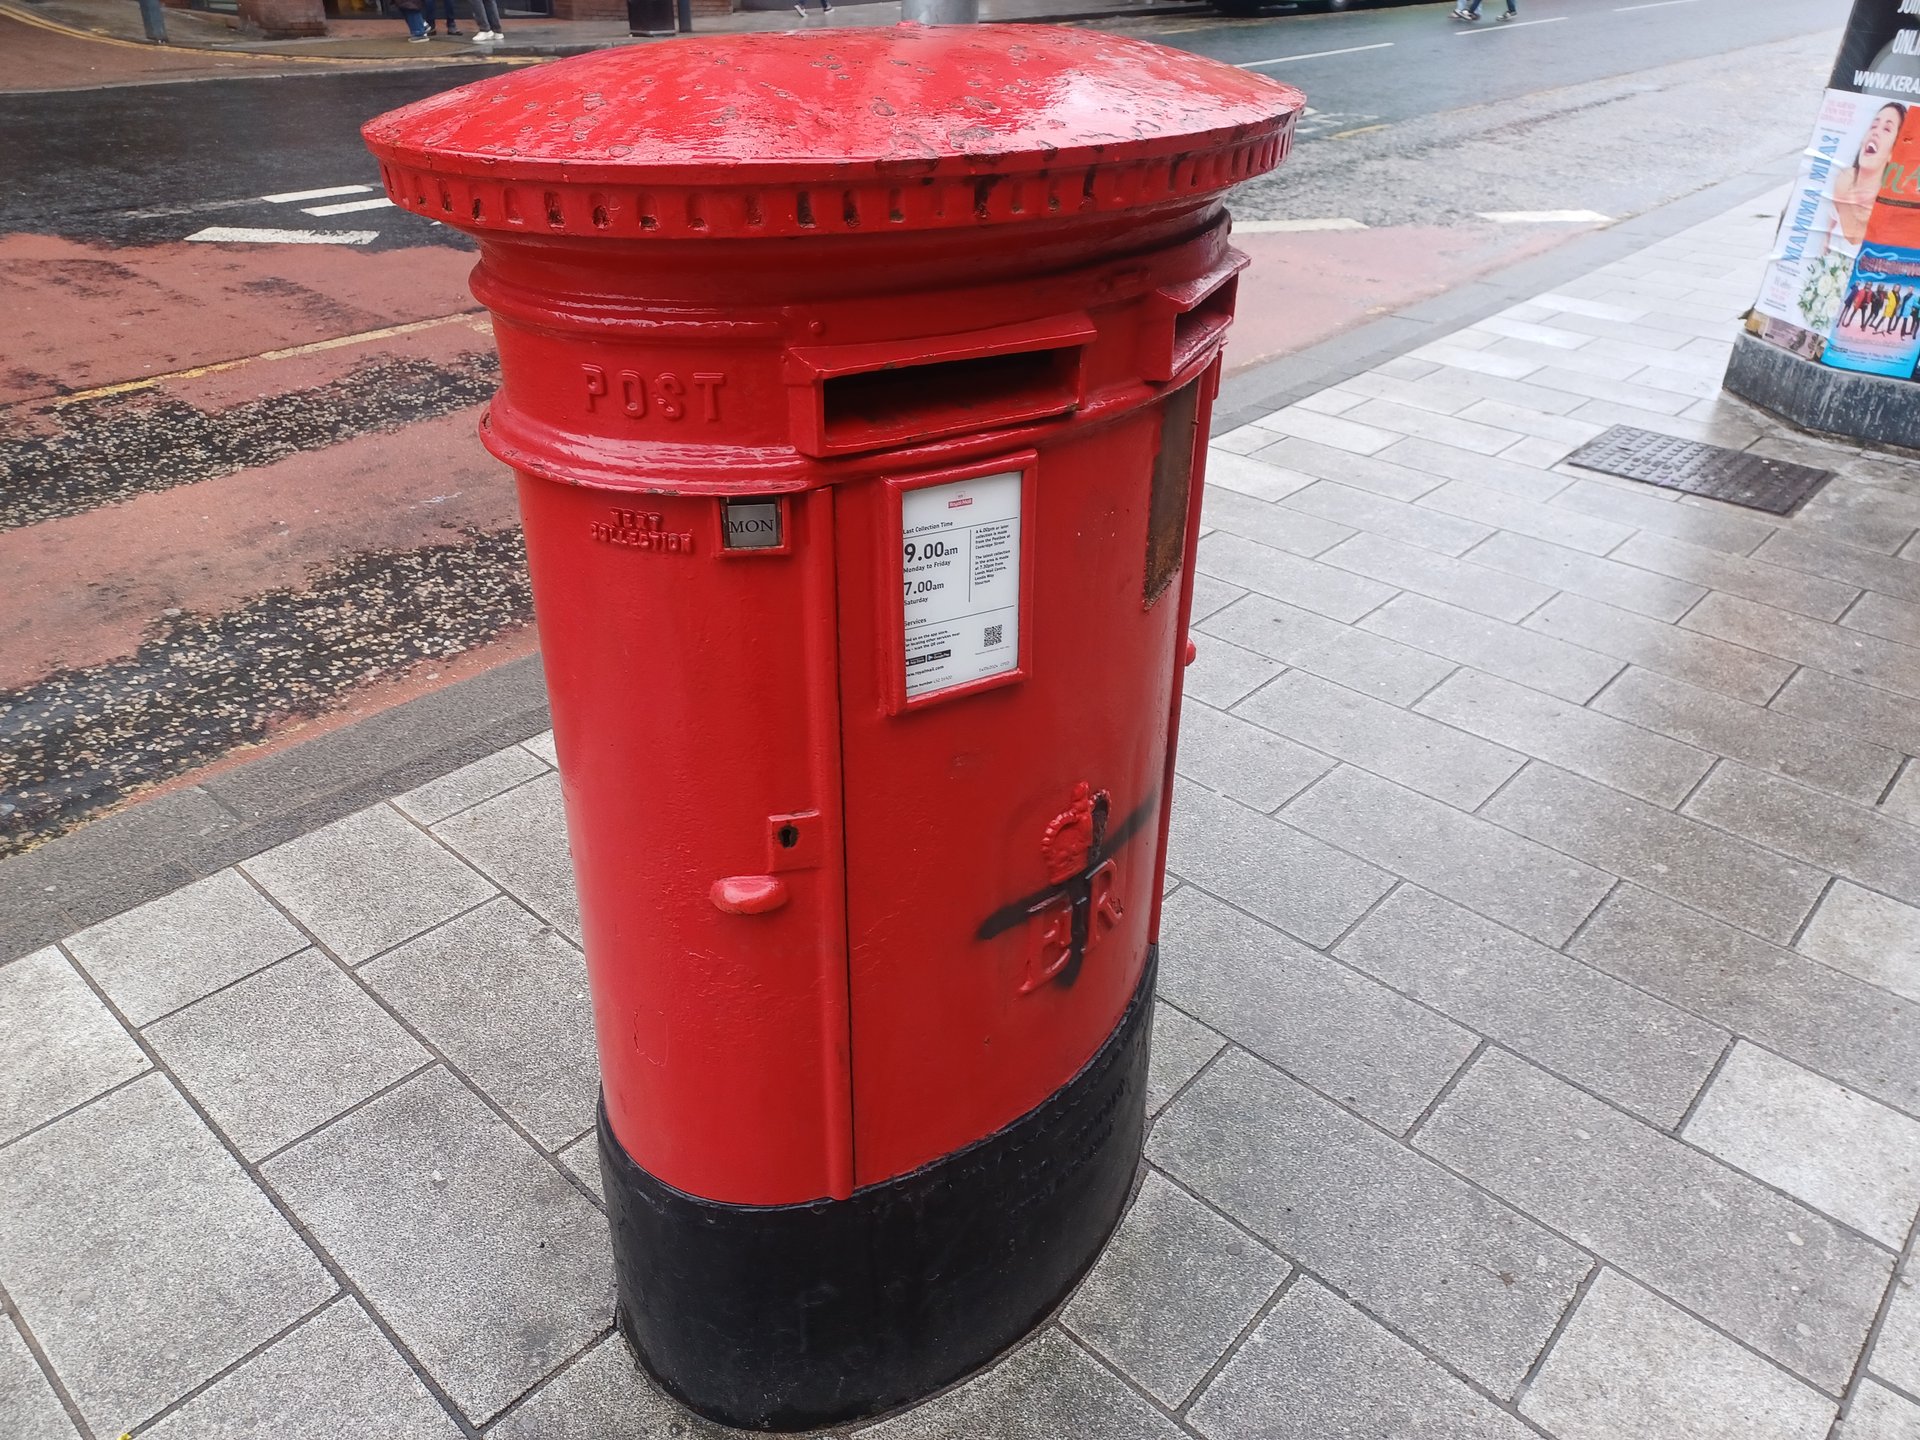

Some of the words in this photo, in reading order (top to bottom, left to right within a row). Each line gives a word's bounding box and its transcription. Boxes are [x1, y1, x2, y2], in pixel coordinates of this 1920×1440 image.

[1783, 188, 1822, 264] MAMMA
[581, 363, 726, 422] POST
[728, 518, 776, 535] MON
[916, 524, 940, 532] Collection
[590, 520, 694, 554] COLLECTION
[904, 542, 958, 563] 9.00am
[904, 580, 944, 596] 7.00am
[904, 597, 928, 606] Saturday
[904, 618, 926, 626] Services
